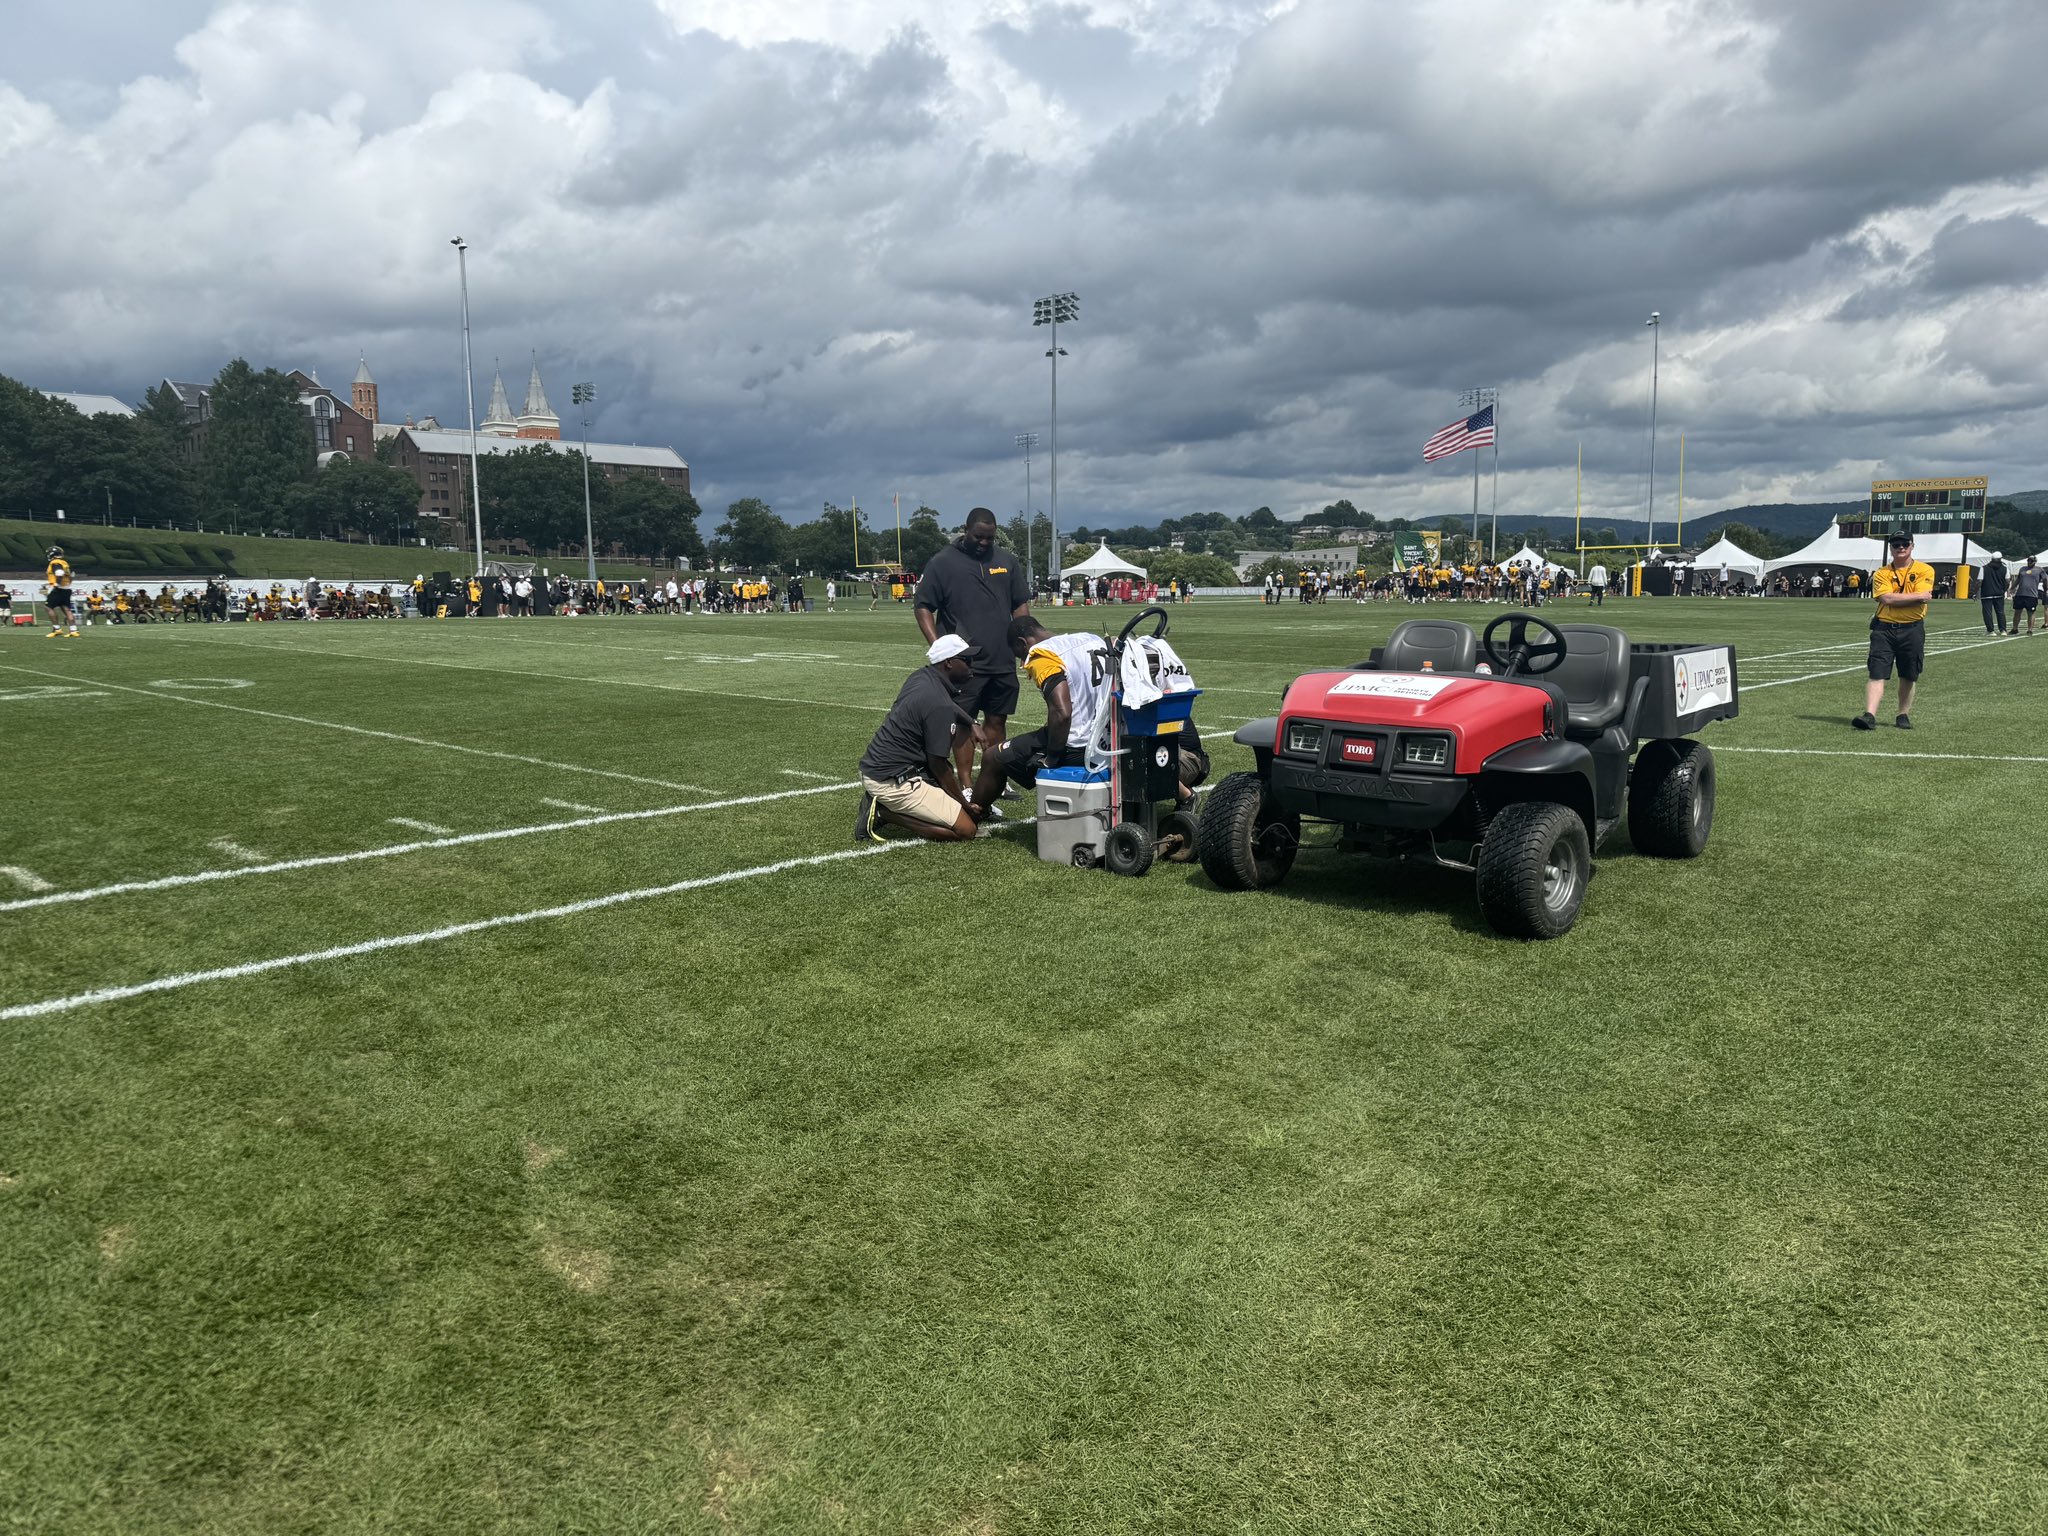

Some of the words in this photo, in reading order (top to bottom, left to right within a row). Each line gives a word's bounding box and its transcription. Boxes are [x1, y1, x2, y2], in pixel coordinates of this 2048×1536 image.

[1873, 482, 1895, 490] SAINT
[1898, 480, 1931, 489] VINCENT
[1933, 479, 1971, 488] COLLEGE
[1877, 492, 1892, 500] SVC
[1961, 488, 1984, 497] GUEST
[1872, 514, 1895, 522] DOWN
[1904, 513, 1913, 521] TO
[1915, 513, 1926, 521] GO
[1926, 512, 1942, 521] BALL
[1943, 512, 1954, 520] ON
[1694, 669, 1714, 691] UPMC
[1333, 684, 1391, 693] UPMC
[1294, 772, 1415, 800] WORKMAN
